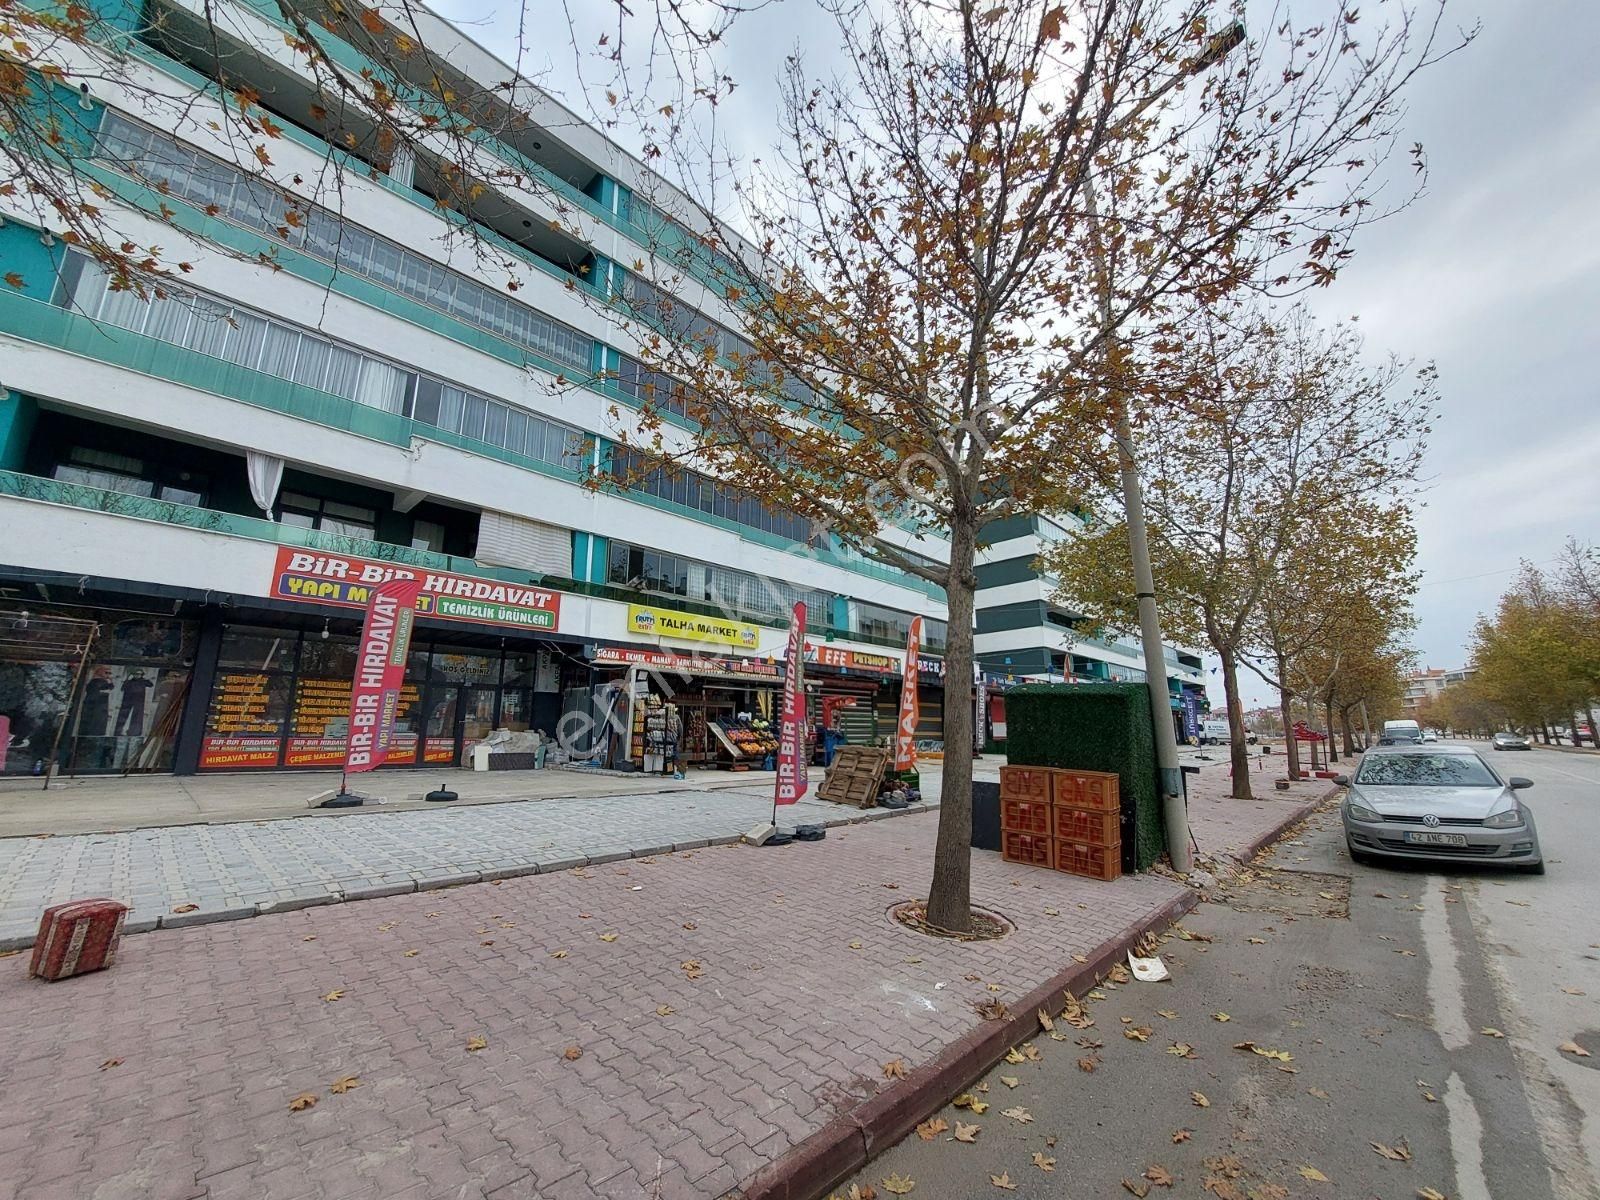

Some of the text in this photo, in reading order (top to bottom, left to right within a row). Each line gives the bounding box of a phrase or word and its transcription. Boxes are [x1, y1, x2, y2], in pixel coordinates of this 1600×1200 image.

[288, 578, 340, 599] YAPI
[422, 575, 552, 608] HIRDAVAT
[442, 602, 549, 625] TEMİZLİK ÜRÜNLERİ
[660, 617, 738, 638] TALHA MARKET
[360, 594, 398, 688] HIRDAVAT
[625, 652, 646, 663] EKMEK
[784, 613, 801, 715] HIRDAVAT
[825, 650, 847, 666] EFE
[898, 633, 918, 763] MARKET
[377, 693, 396, 749] YAPI MARKET
[797, 719, 805, 758] MARKET
[206, 752, 275, 764] HIRDAVAT MALZ.
[1411, 833, 1422, 842] 42
